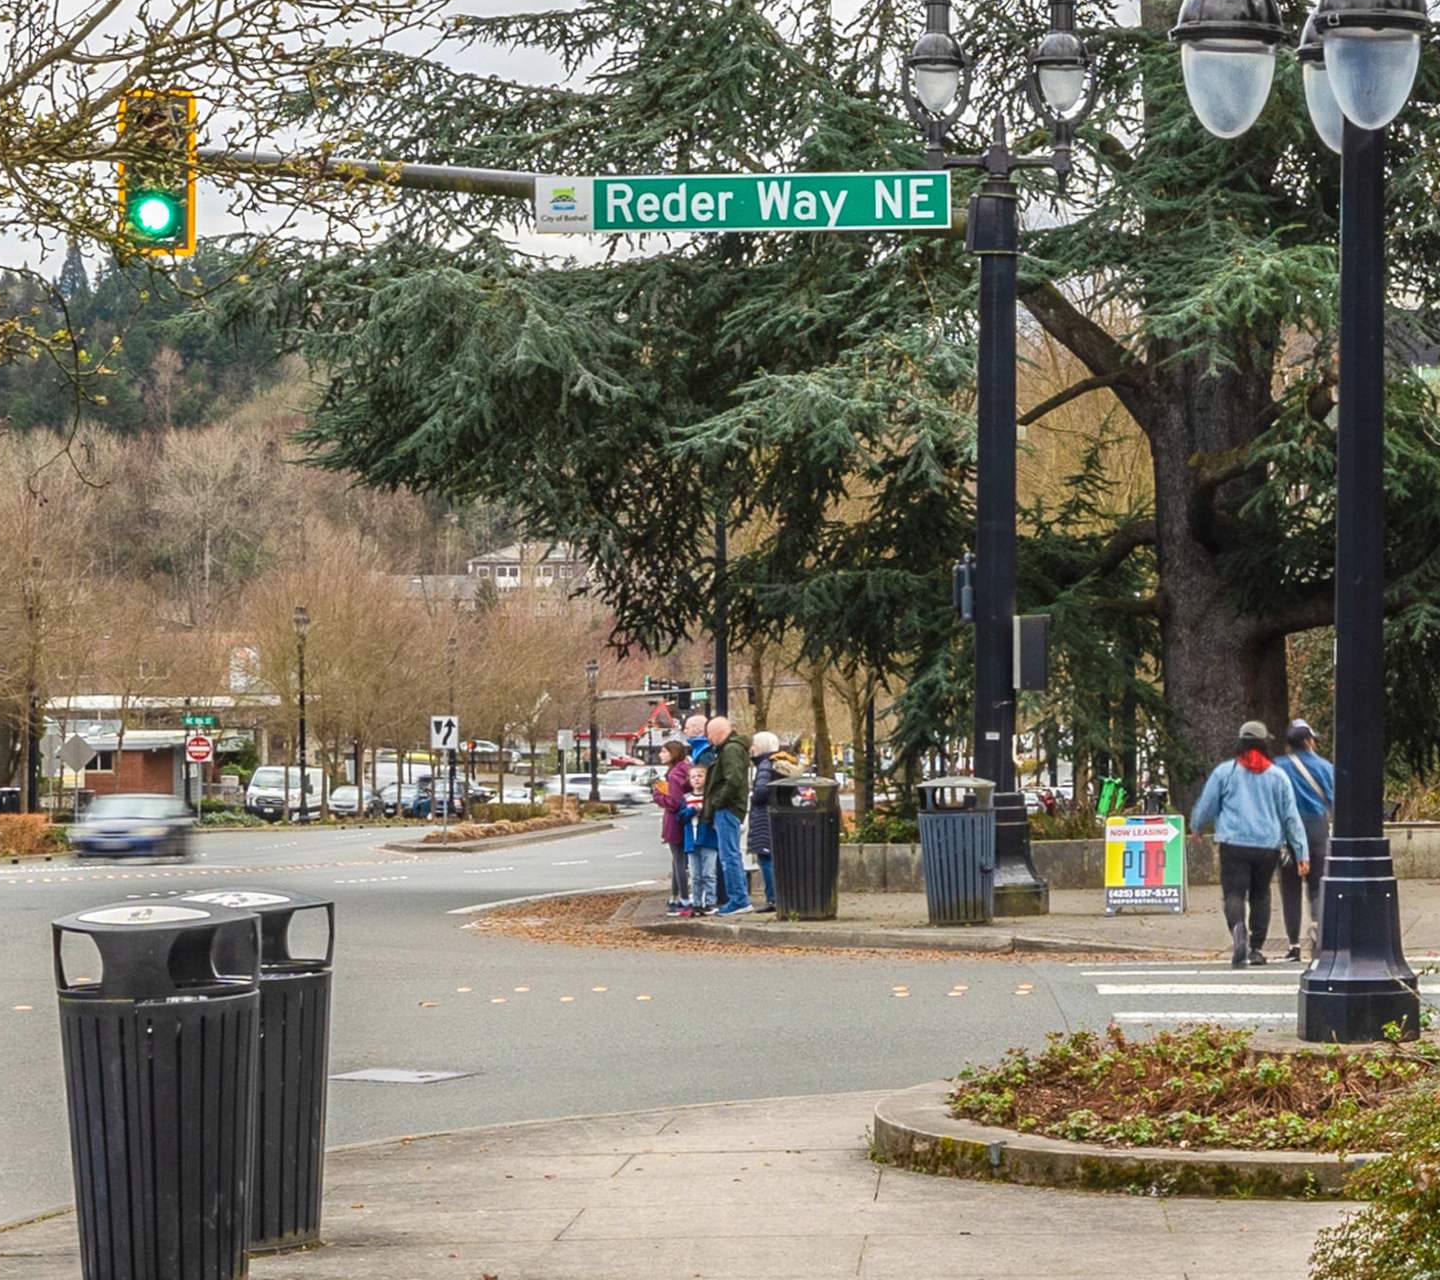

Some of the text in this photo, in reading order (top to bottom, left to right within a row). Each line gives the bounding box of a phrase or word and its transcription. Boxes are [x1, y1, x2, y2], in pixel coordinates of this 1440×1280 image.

[606, 178, 935, 228] Reder Way NE
[1110, 828, 1169, 837] NOW LEASING
[1122, 849, 1167, 879] POP
[1108, 888, 1134, 898] (425)
